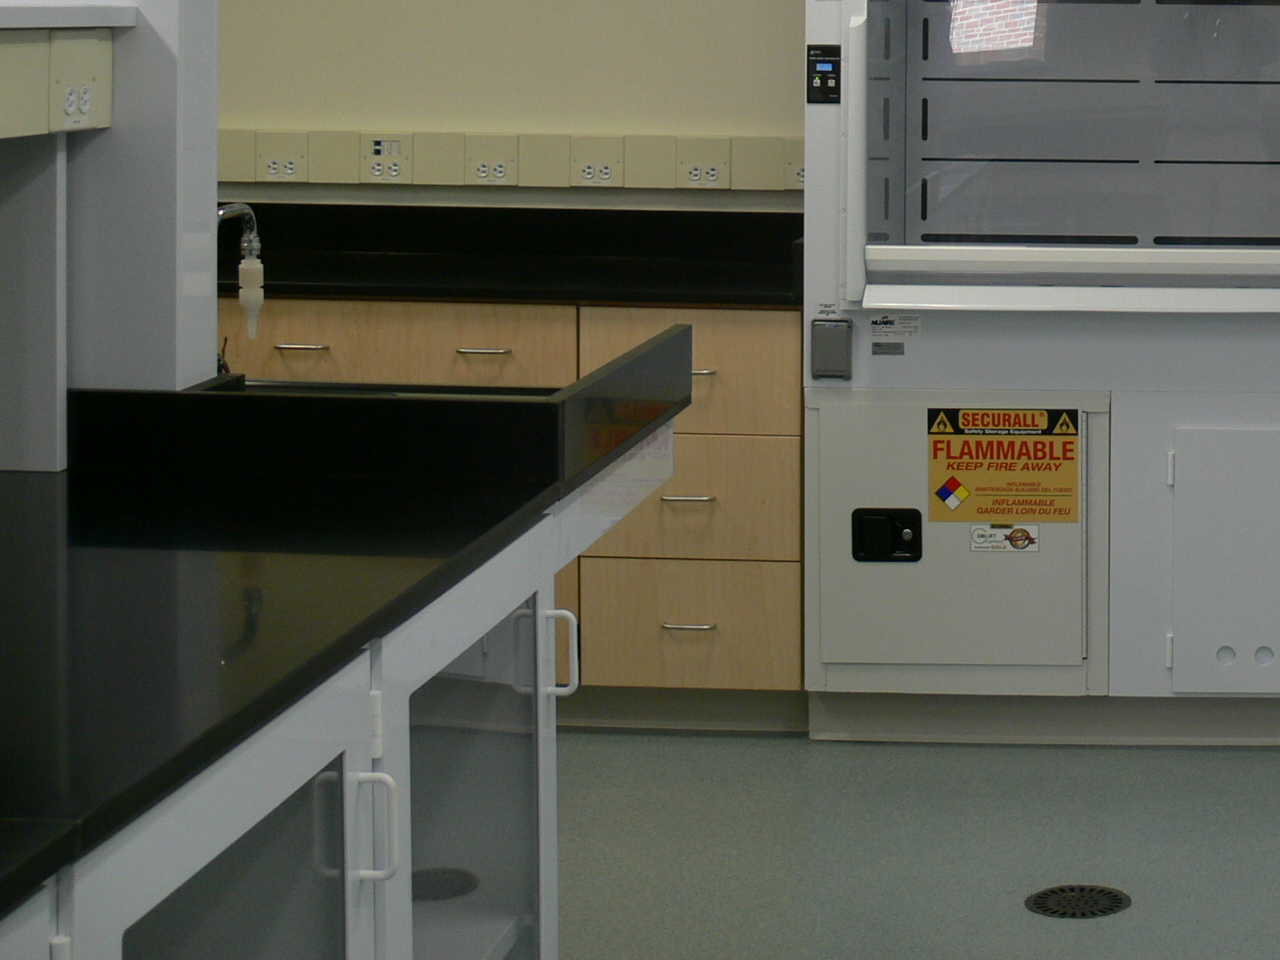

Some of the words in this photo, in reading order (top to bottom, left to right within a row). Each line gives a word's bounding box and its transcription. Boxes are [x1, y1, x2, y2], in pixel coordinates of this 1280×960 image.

[932, 440, 1075, 461] FLAMMABLE
[946, 462, 983, 471] KEEP
[986, 462, 1017, 471] FIRE
[1020, 462, 1063, 472] AWAY
[992, 499, 1056, 507] INFLAMMABLE
[976, 507, 1014, 515] GARDER
[1015, 507, 1037, 515] LOIN
[1038, 507, 1051, 515] DU
[1053, 508, 1071, 516] FEU
